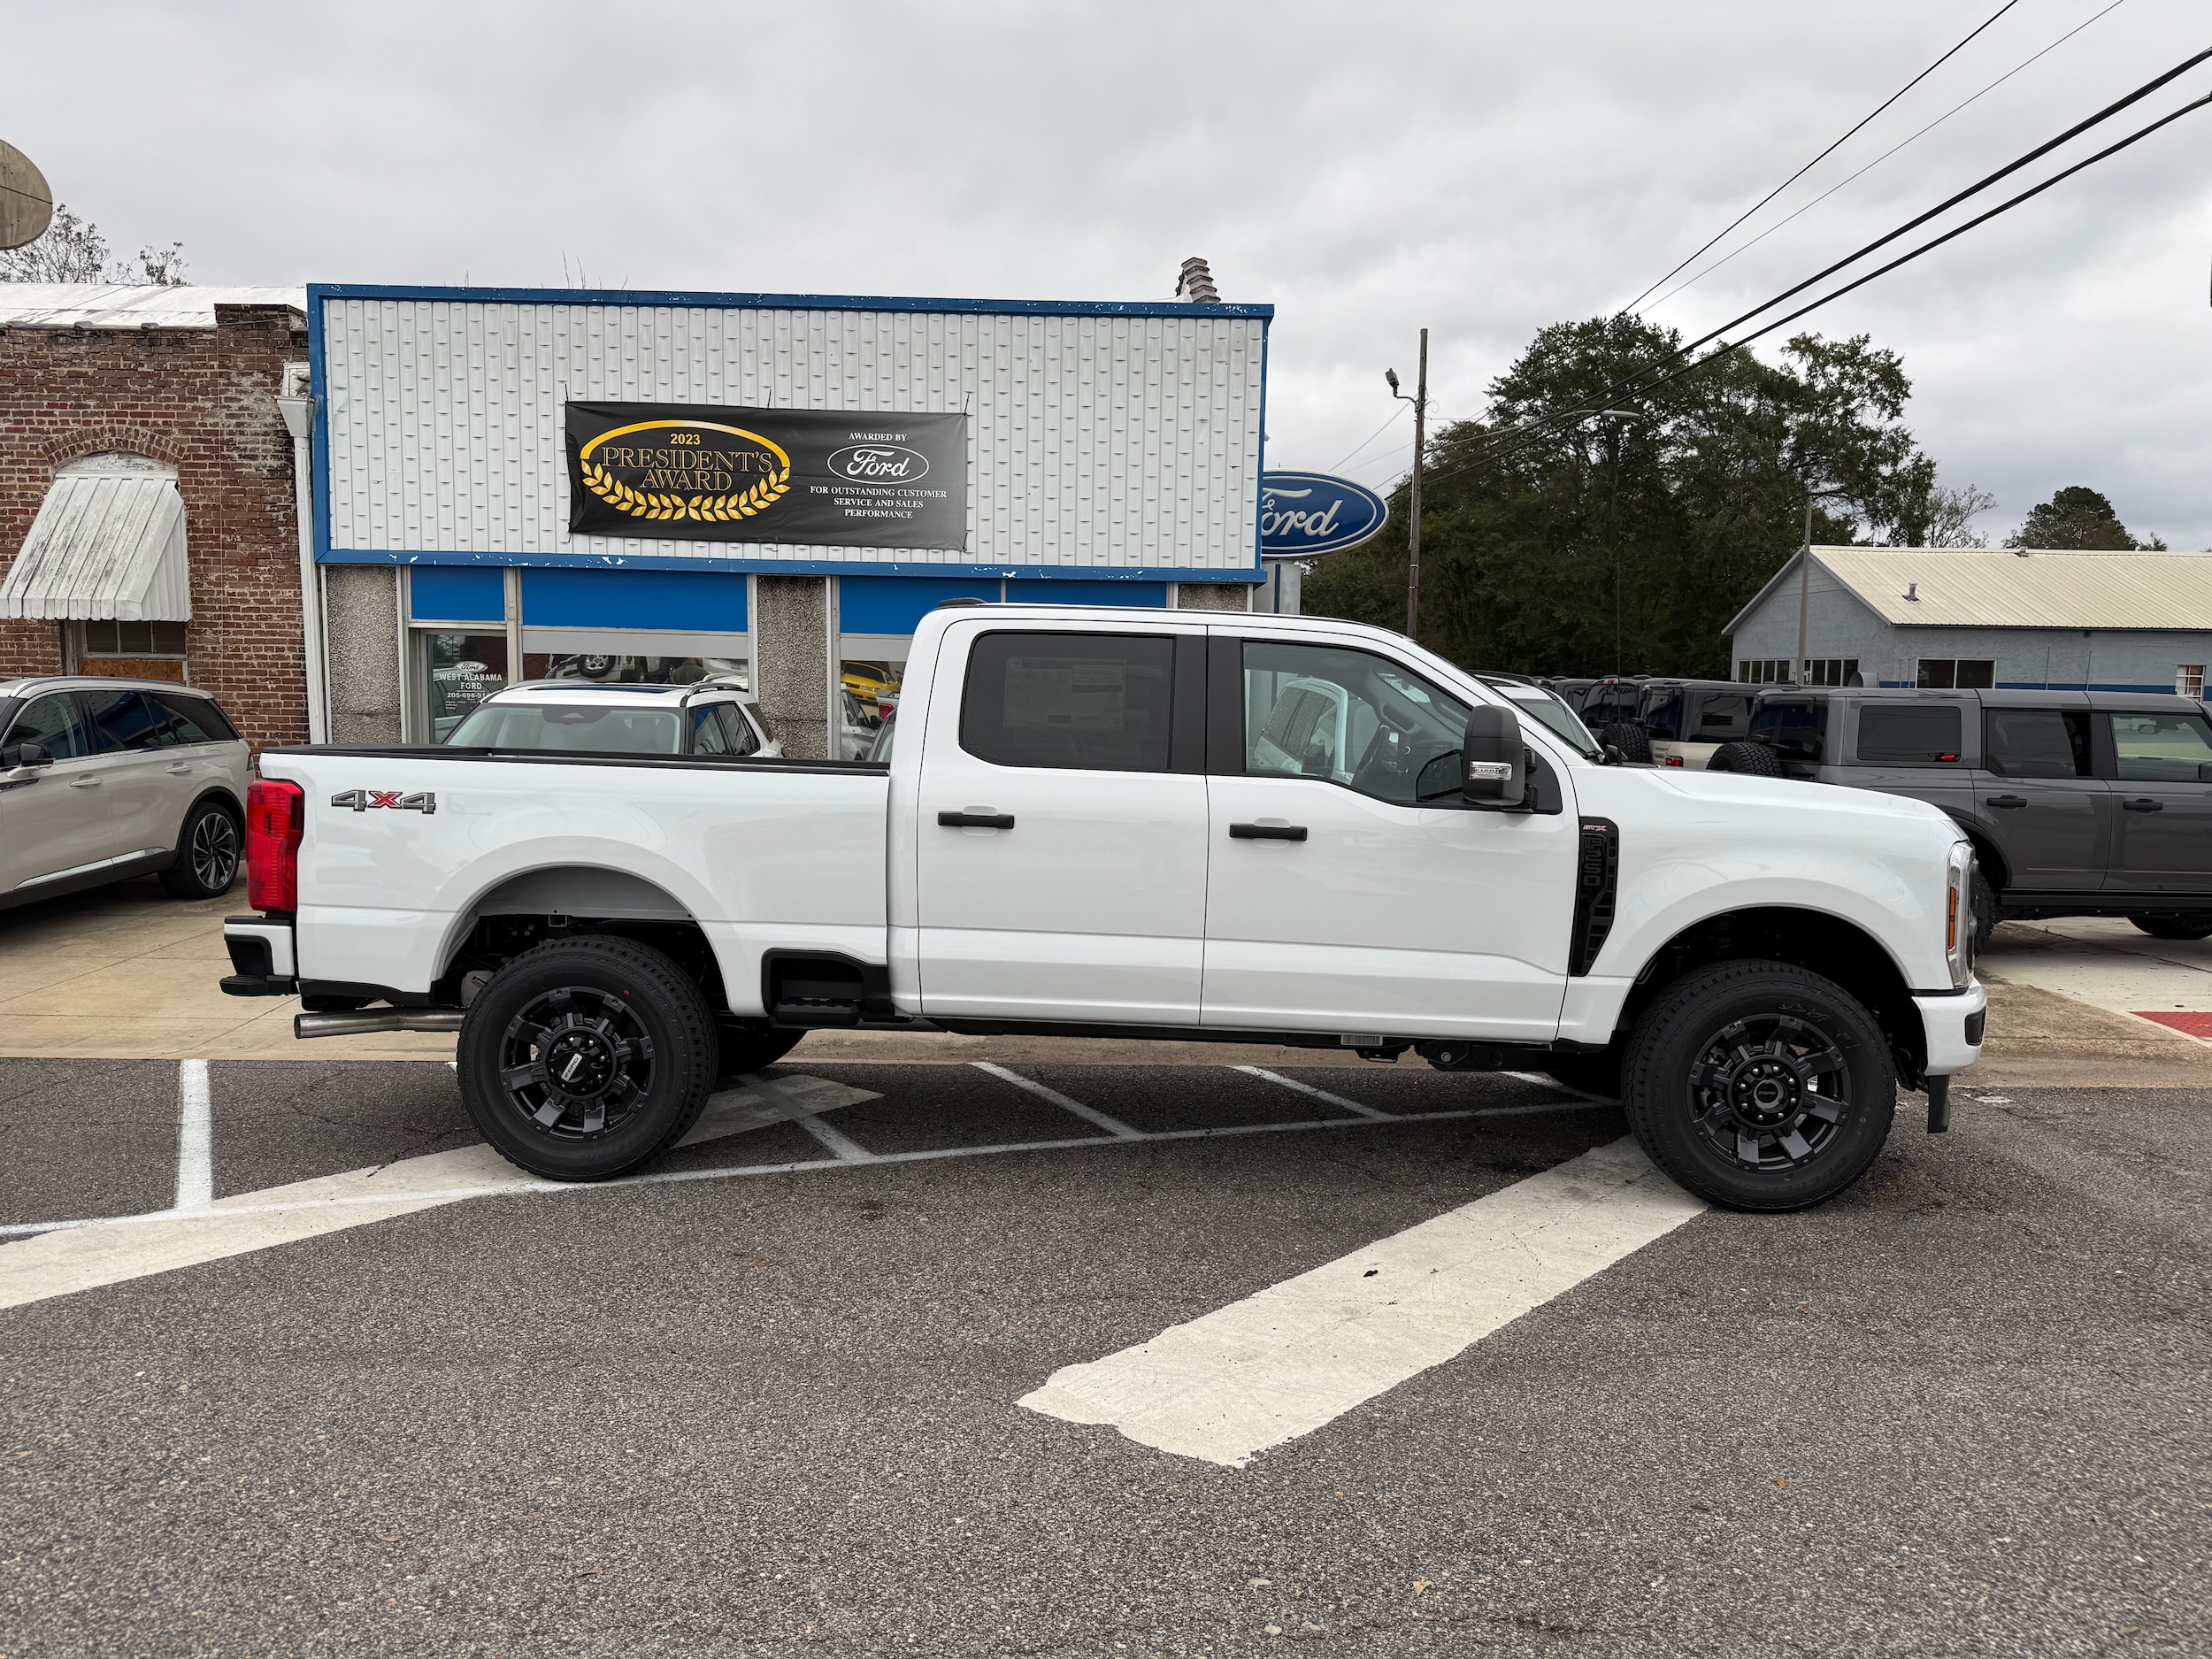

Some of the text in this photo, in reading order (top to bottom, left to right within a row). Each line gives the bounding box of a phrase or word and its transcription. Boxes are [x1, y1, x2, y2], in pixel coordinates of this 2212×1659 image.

[670, 433, 701, 445] 2023
[849, 432, 893, 442] AWARDED
[602, 446, 773, 472] PRESIDENT'S
[846, 449, 910, 477] Ford
[639, 469, 733, 491] AWARD
[810, 486, 948, 498] FOR OUTSTANDING CUSTOMER
[833, 497, 924, 509] SERVICE AND SALES
[844, 509, 914, 519] PERFORMANCE
[565, 1057, 579, 1078] FORD
